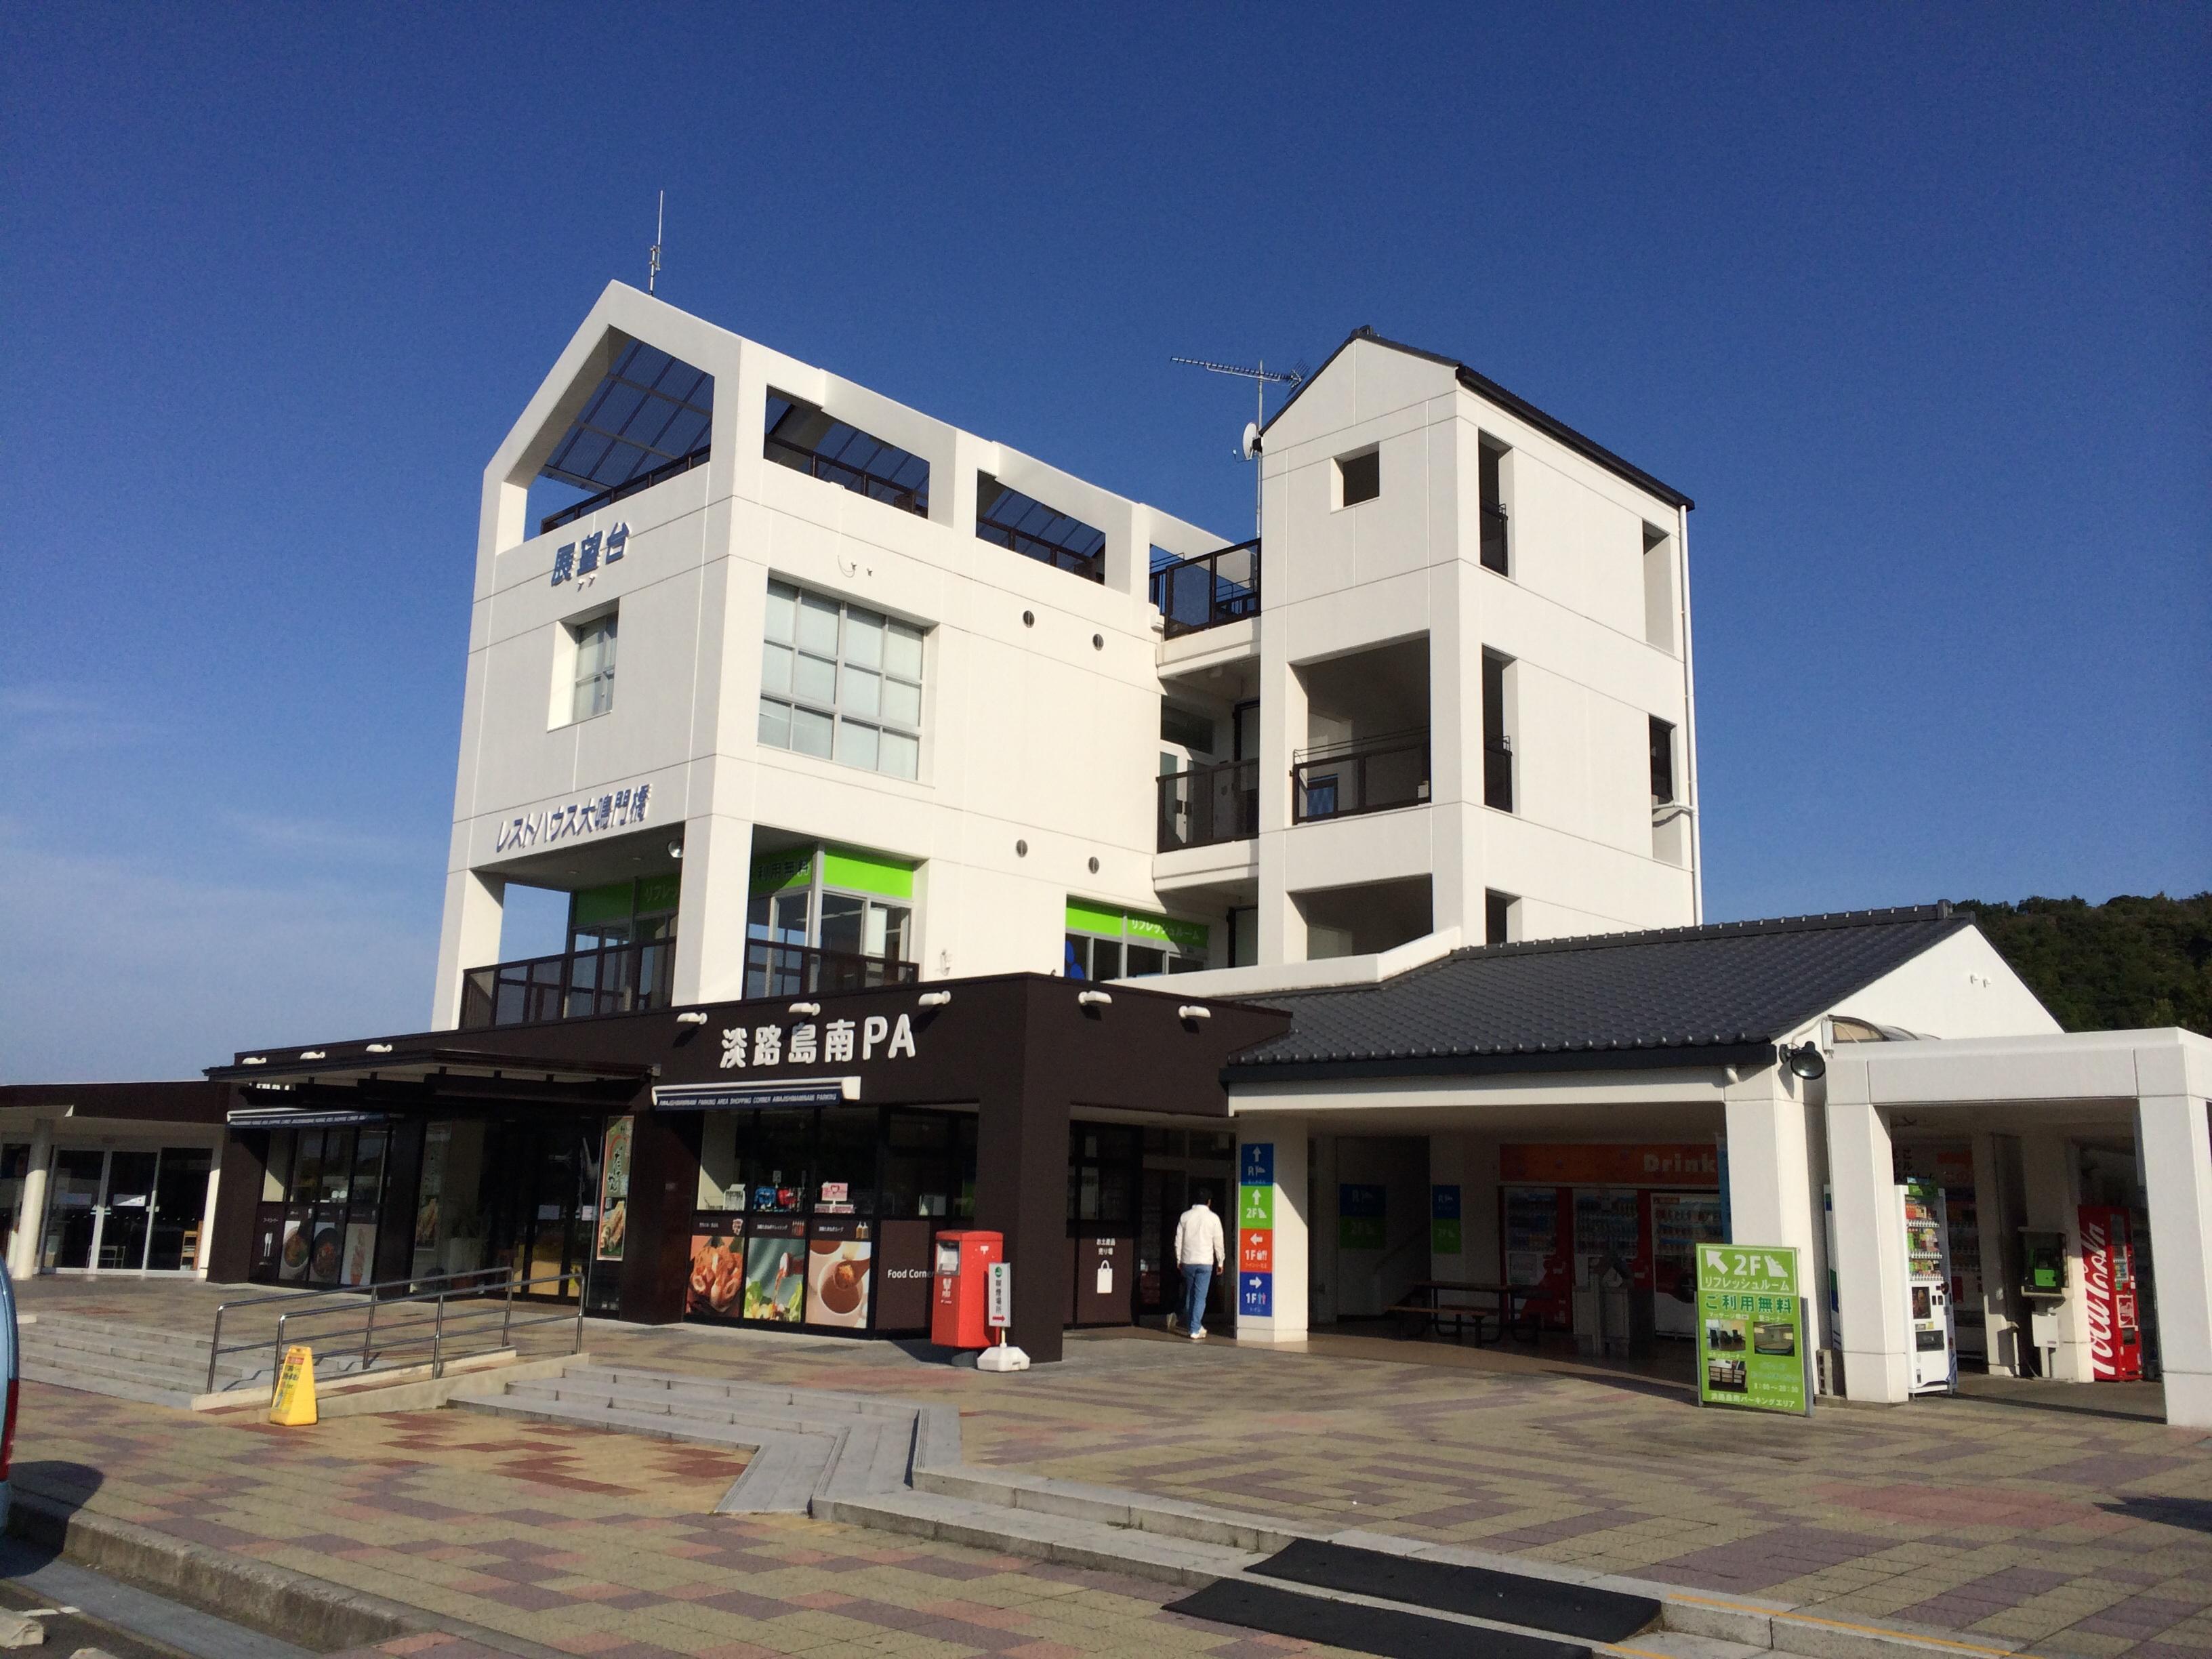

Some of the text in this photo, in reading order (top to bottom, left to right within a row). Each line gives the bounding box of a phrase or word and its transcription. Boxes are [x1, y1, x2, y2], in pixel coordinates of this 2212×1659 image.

[550, 521, 630, 588] 展望台
[496, 783, 653, 853] レストハウス大鳴門橋
[720, 1014, 916, 1069] 淡路島南PA
[716, 1097, 729, 1105] AREA
[1643, 1153, 1717, 1173] Drink
[1246, 1208, 1258, 1218] 2F
[1245, 1250, 1256, 1261] 1F
[887, 1269, 907, 1279] Food
[1733, 1254, 1761, 1276] 2F
[1705, 1276, 1790, 1292] リフレッシュルーム
[1246, 1292, 1257, 1304] 1F
[1705, 1294, 1793, 1314] ご利用無料
